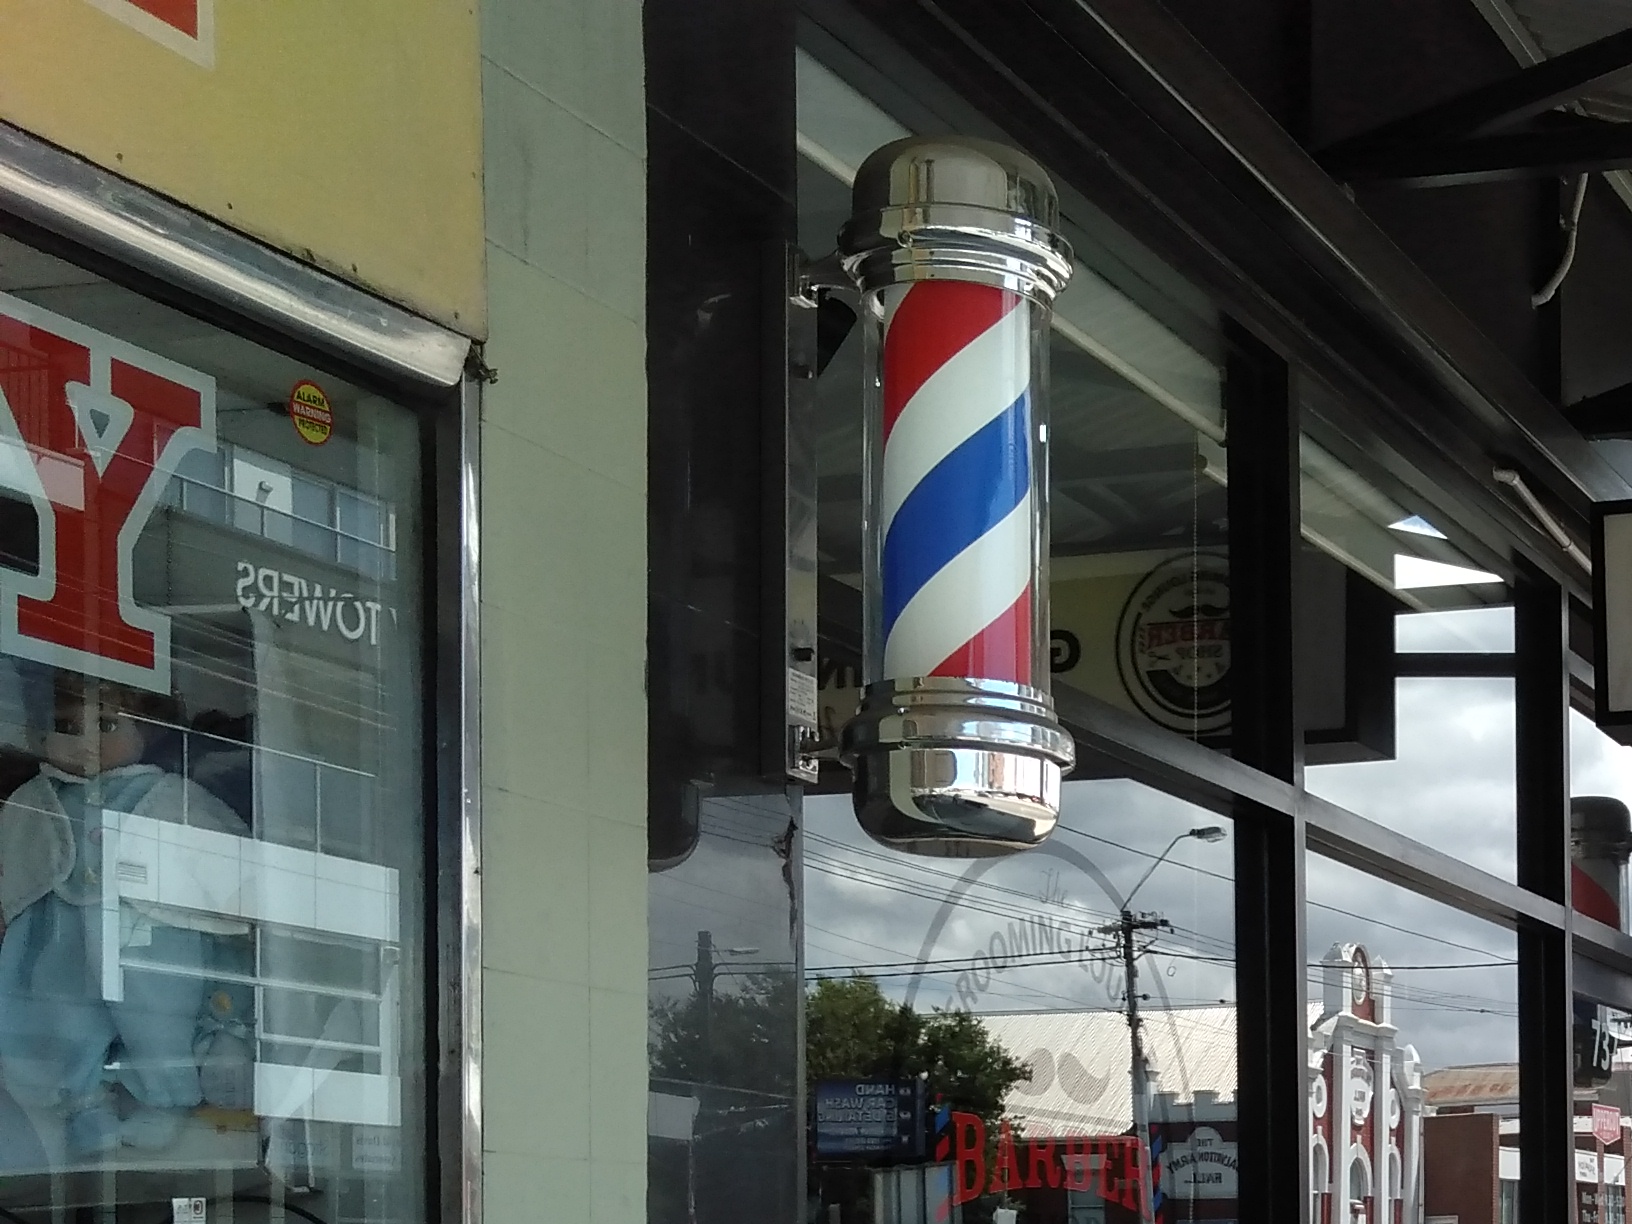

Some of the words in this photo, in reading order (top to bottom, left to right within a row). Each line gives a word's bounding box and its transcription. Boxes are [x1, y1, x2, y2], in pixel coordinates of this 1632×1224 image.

[296, 390, 325, 407] ALARM
[292, 402, 332, 423] WARNING
[951, 1111, 1152, 1221] BARBER
